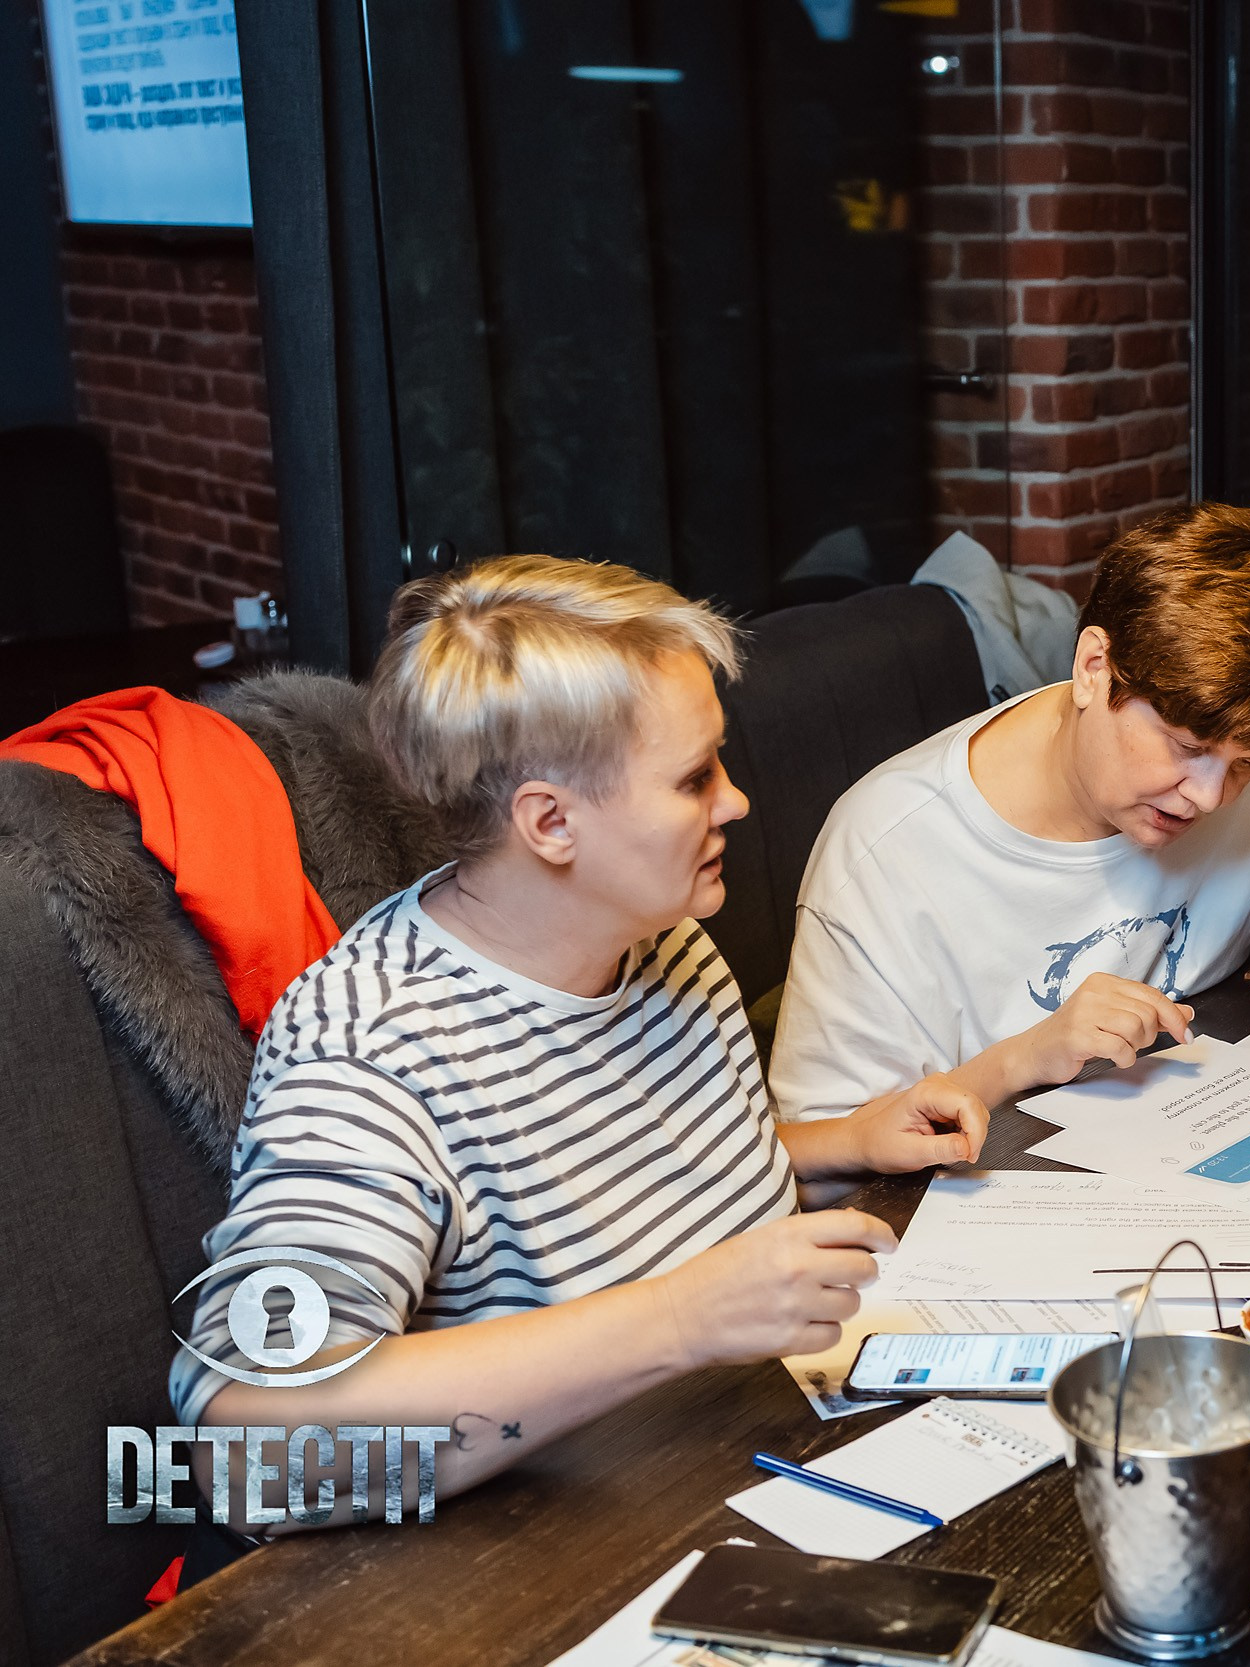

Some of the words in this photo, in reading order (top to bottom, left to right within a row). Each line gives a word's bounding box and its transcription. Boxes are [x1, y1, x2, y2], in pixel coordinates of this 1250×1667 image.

[1212, 1079, 1243, 1096] укажет
[1201, 1094, 1212, 1102] на
[1237, 1109, 1246, 1117] to
[1225, 1115, 1239, 1123] the
